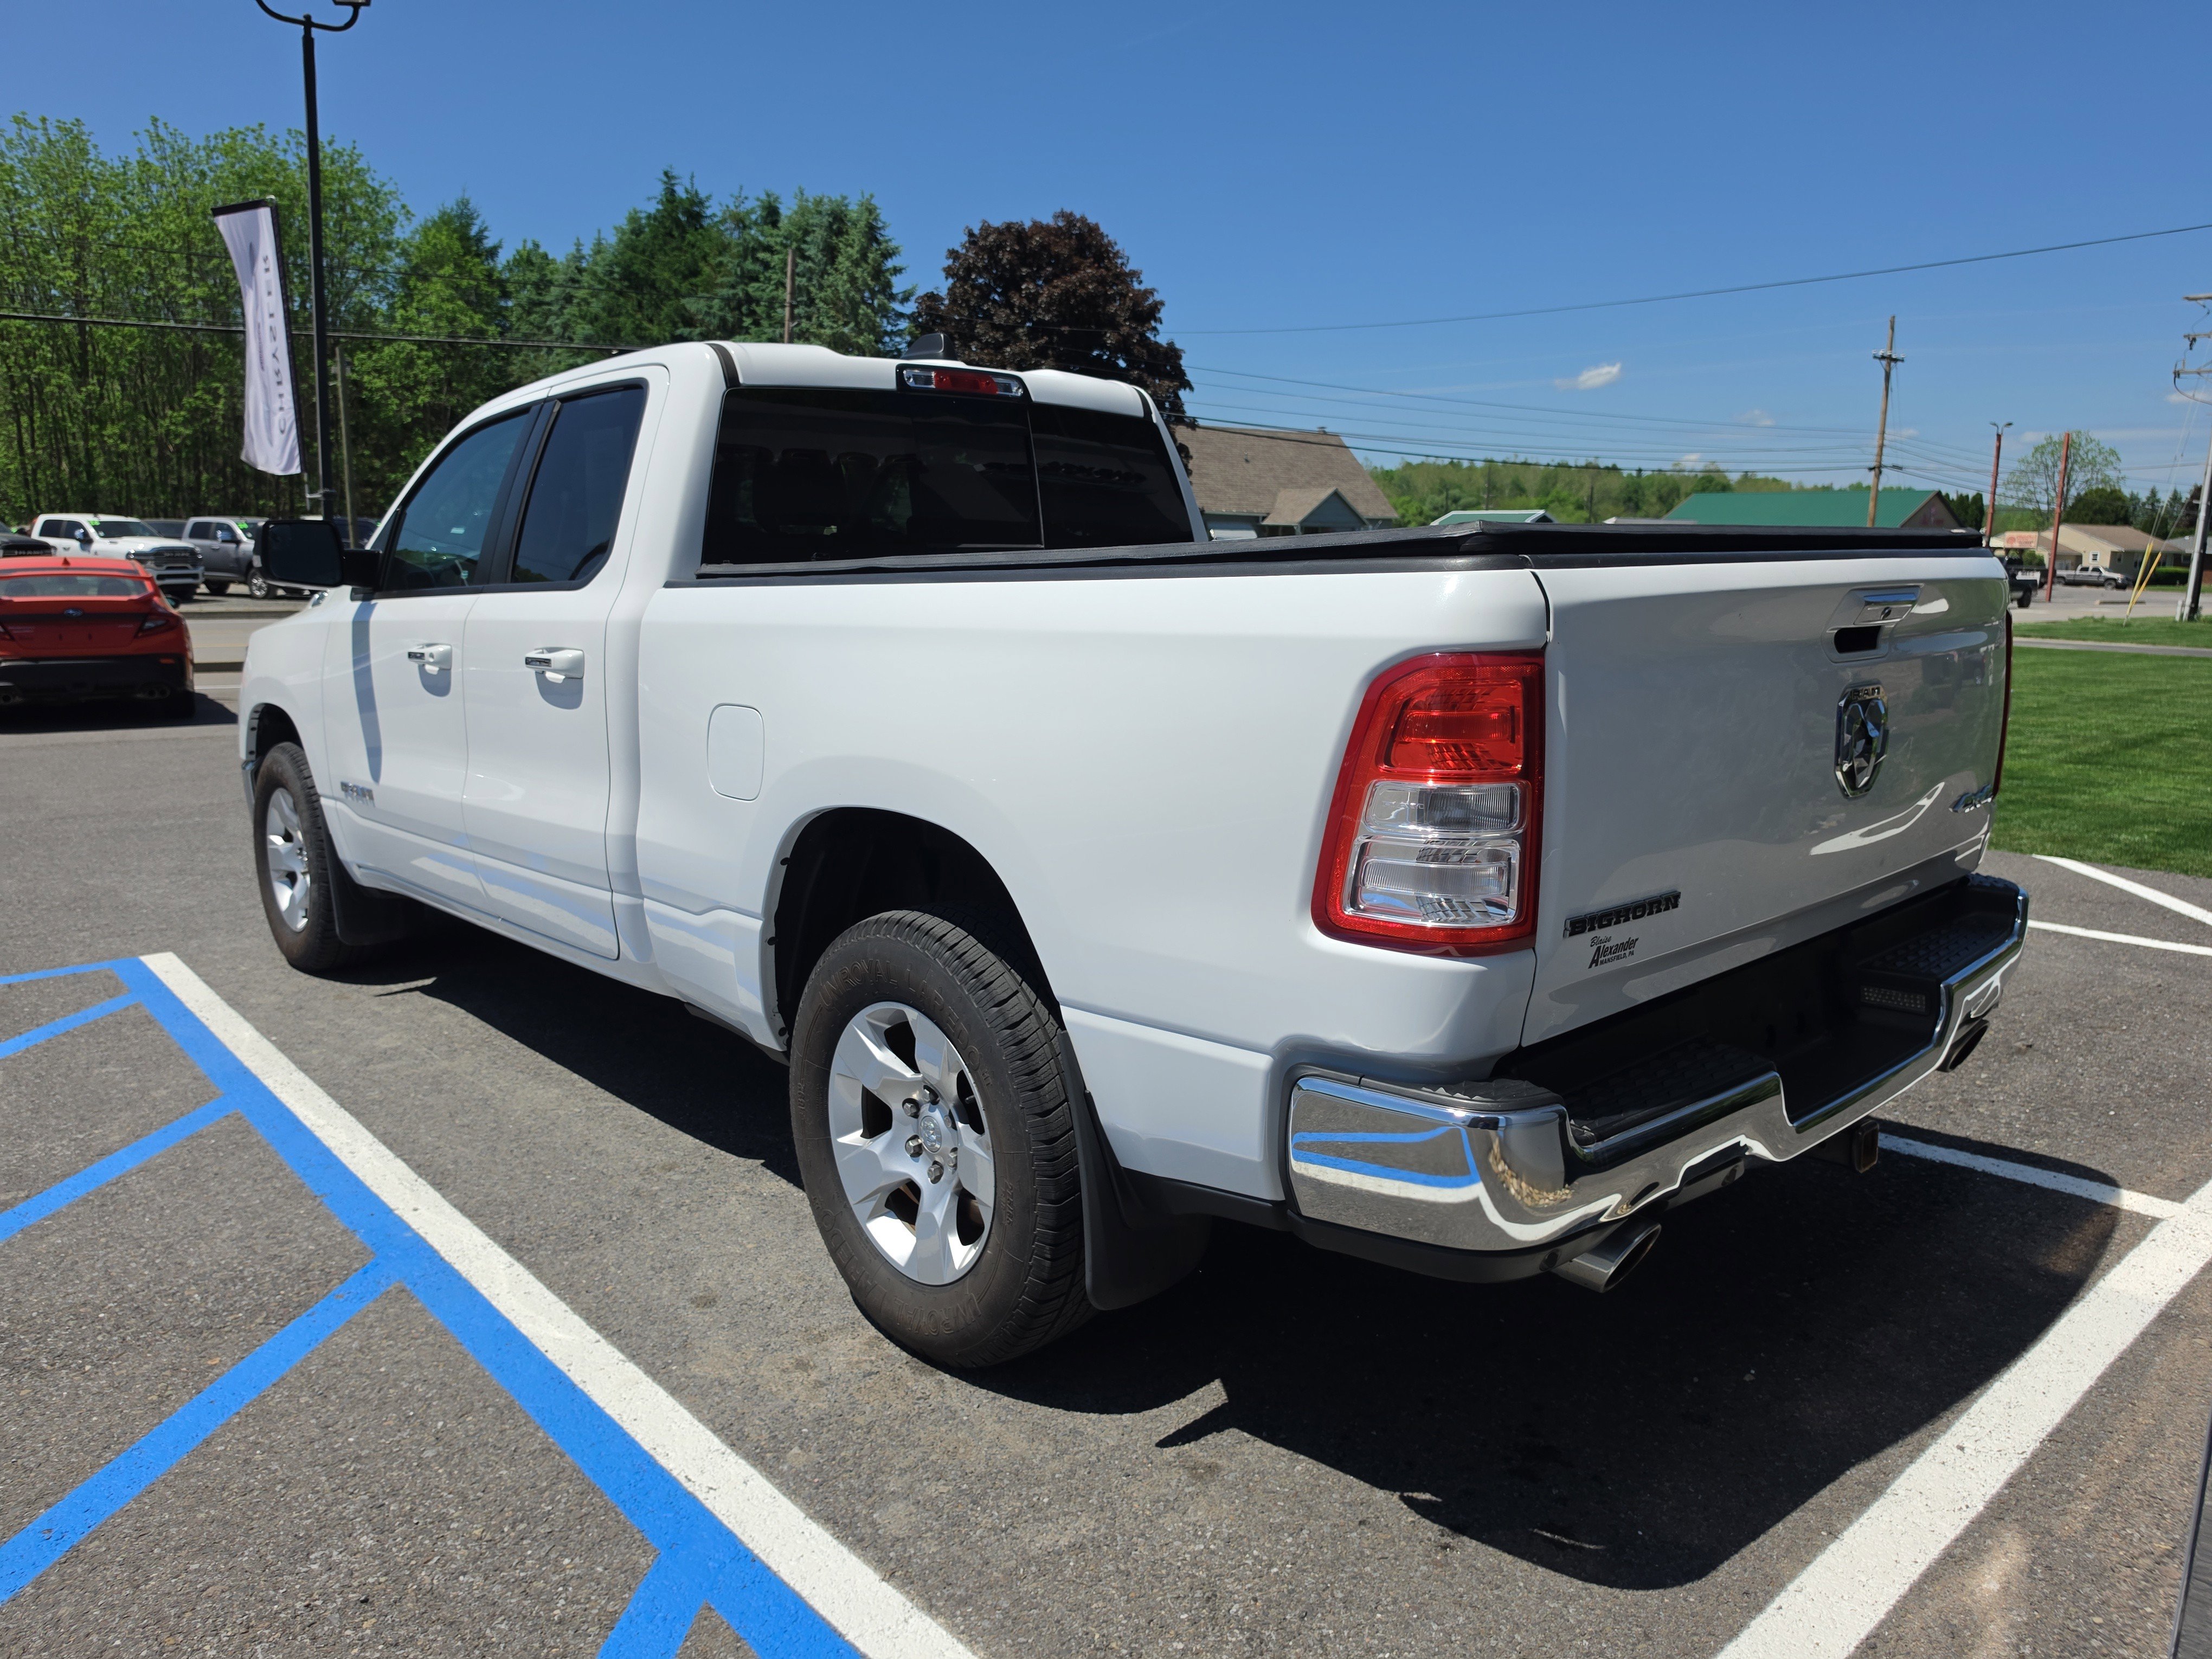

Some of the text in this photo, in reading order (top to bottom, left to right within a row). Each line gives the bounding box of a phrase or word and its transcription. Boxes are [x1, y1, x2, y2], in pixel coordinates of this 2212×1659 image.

[1850, 686, 1881, 700] RAM
[1564, 890, 1681, 938] BIGHORN
[1588, 937, 1639, 969] Alexander
[1590, 936, 1612, 947] Blaise
[1599, 953, 1628, 966] MANSFIELD,
[818, 959, 898, 1007] UNIROYAL
